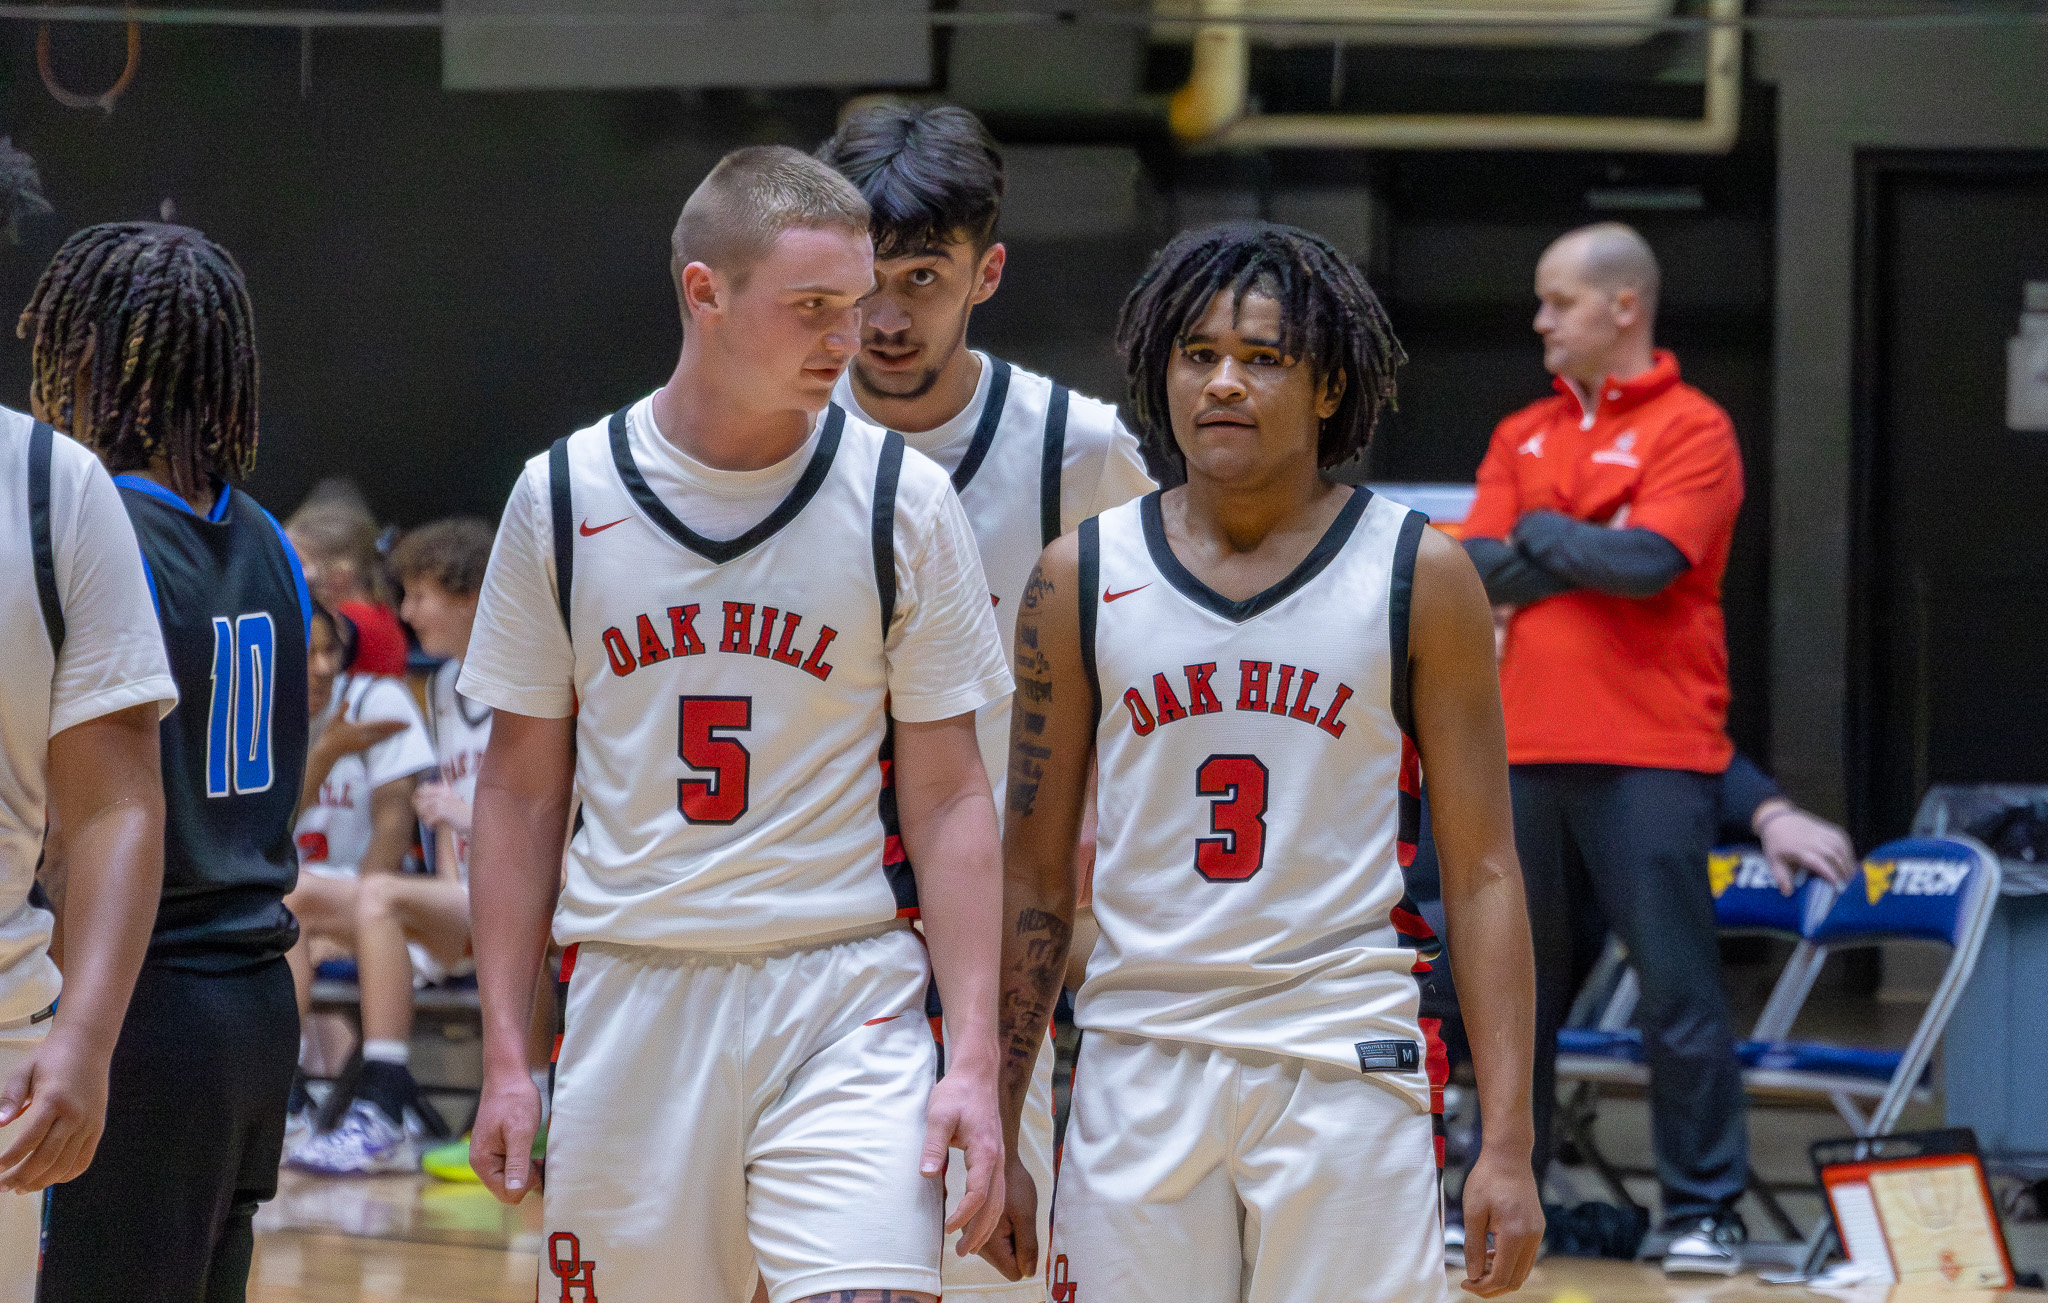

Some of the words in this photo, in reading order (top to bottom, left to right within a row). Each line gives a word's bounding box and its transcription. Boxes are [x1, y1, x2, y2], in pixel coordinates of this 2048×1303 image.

[602, 603, 705, 677] OAK
[718, 600, 838, 681] HILL
[206, 611, 275, 798] 10
[1123, 661, 1223, 737] OAK
[1235, 659, 1354, 740] HILL
[677, 695, 752, 826] 5
[1194, 754, 1270, 884] 3
[1890, 860, 1972, 896] TECH
[1402, 1048, 1413, 1063] M
